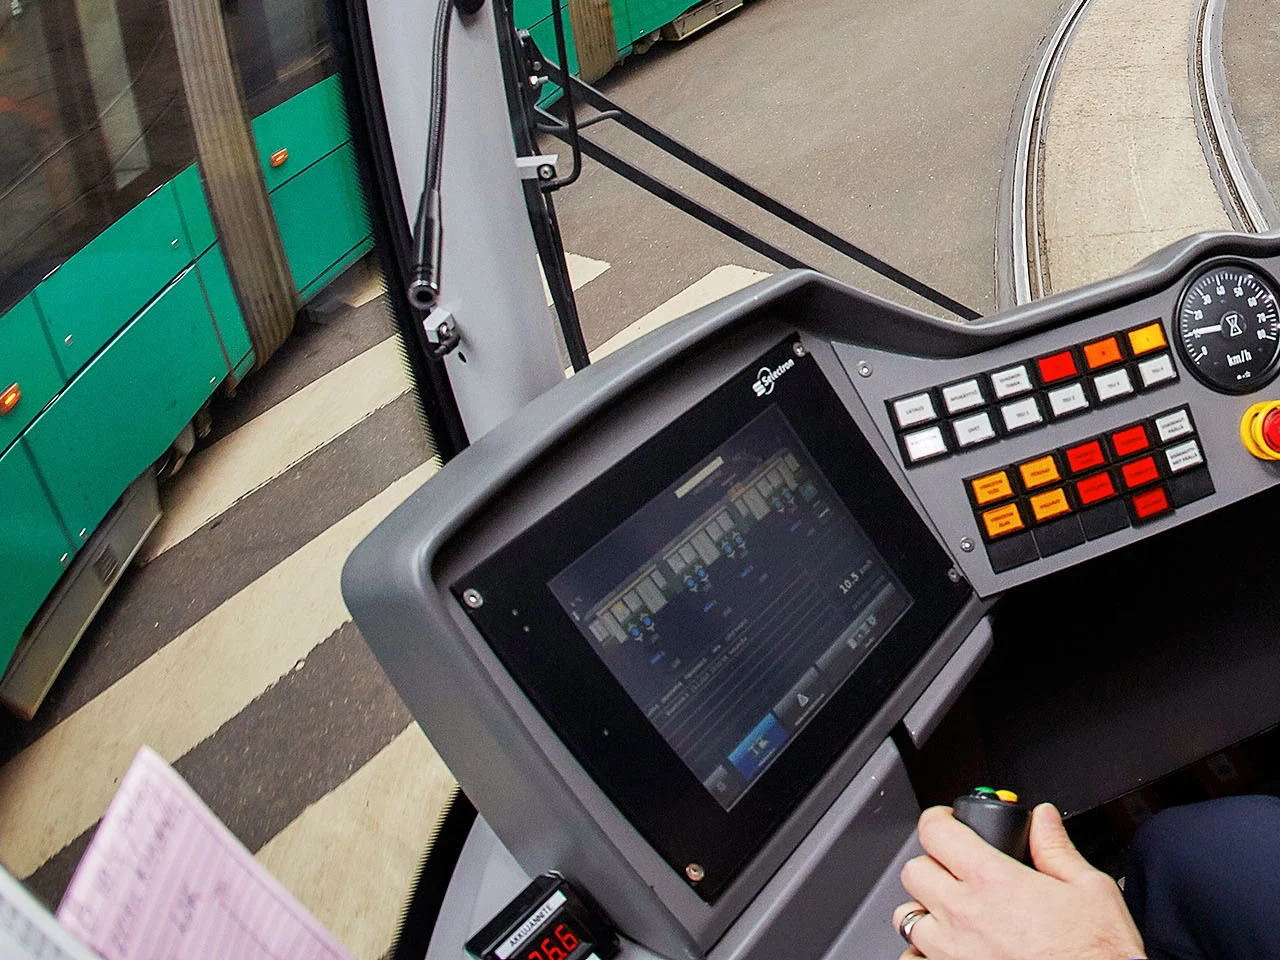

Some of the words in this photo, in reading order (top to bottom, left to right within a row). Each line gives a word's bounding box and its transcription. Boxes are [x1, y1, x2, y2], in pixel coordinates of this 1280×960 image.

[1226, 349, 1252, 367] km/h
[761, 358, 795, 387] Selectron
[839, 571, 859, 594] 10.5
